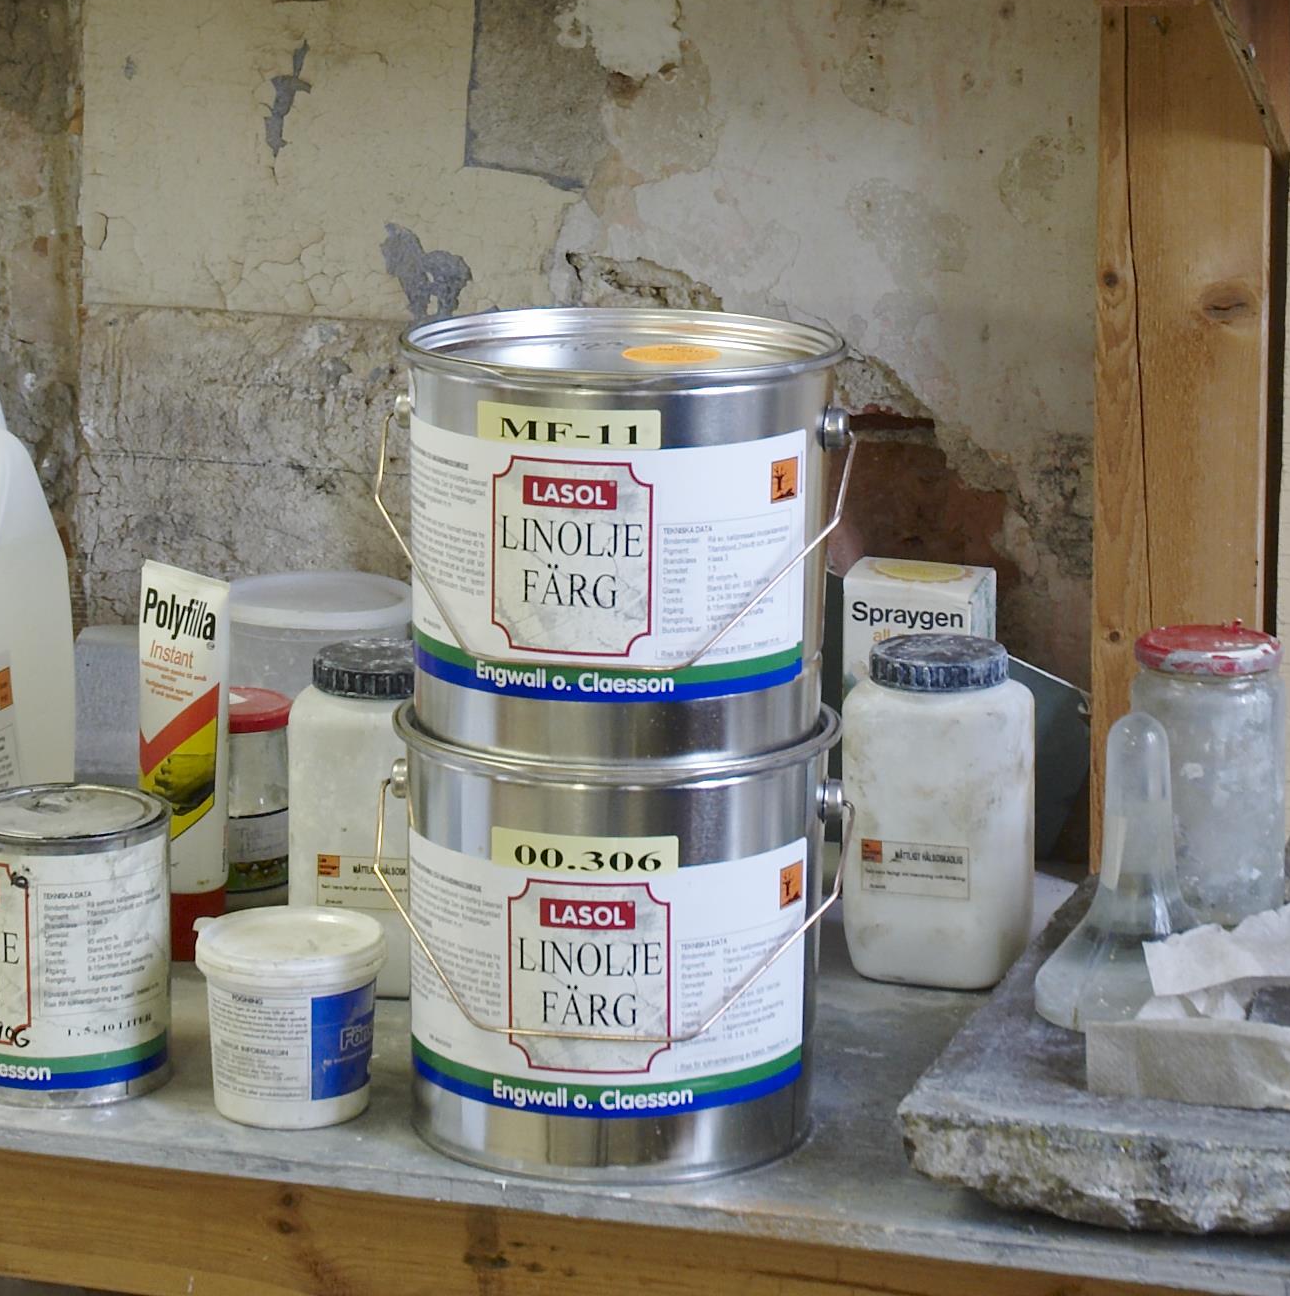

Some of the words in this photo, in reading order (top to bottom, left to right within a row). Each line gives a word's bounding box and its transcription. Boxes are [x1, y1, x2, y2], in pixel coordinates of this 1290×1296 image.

[499, 415, 641, 447] MF-11
[530, 479, 609, 507] LASOL
[500, 514, 646, 560] LINOLJE
[521, 564, 618, 610] FÄRG
[142, 587, 217, 642] Polyfilla
[850, 599, 965, 631] Spraygen
[149, 639, 195, 670] Instant
[474, 658, 548, 692] Engwall
[553, 675, 572, 692] o.
[577, 670, 675, 695] Claesson
[513, 842, 664, 874] 00.306
[549, 902, 627, 928] LASOL
[517, 936, 664, 978] LINOLJE
[541, 984, 639, 1029] FÄRG
[491, 1078, 569, 1110] Engwall
[573, 1093, 594, 1112] o.
[599, 1086, 695, 1112] Claesson
